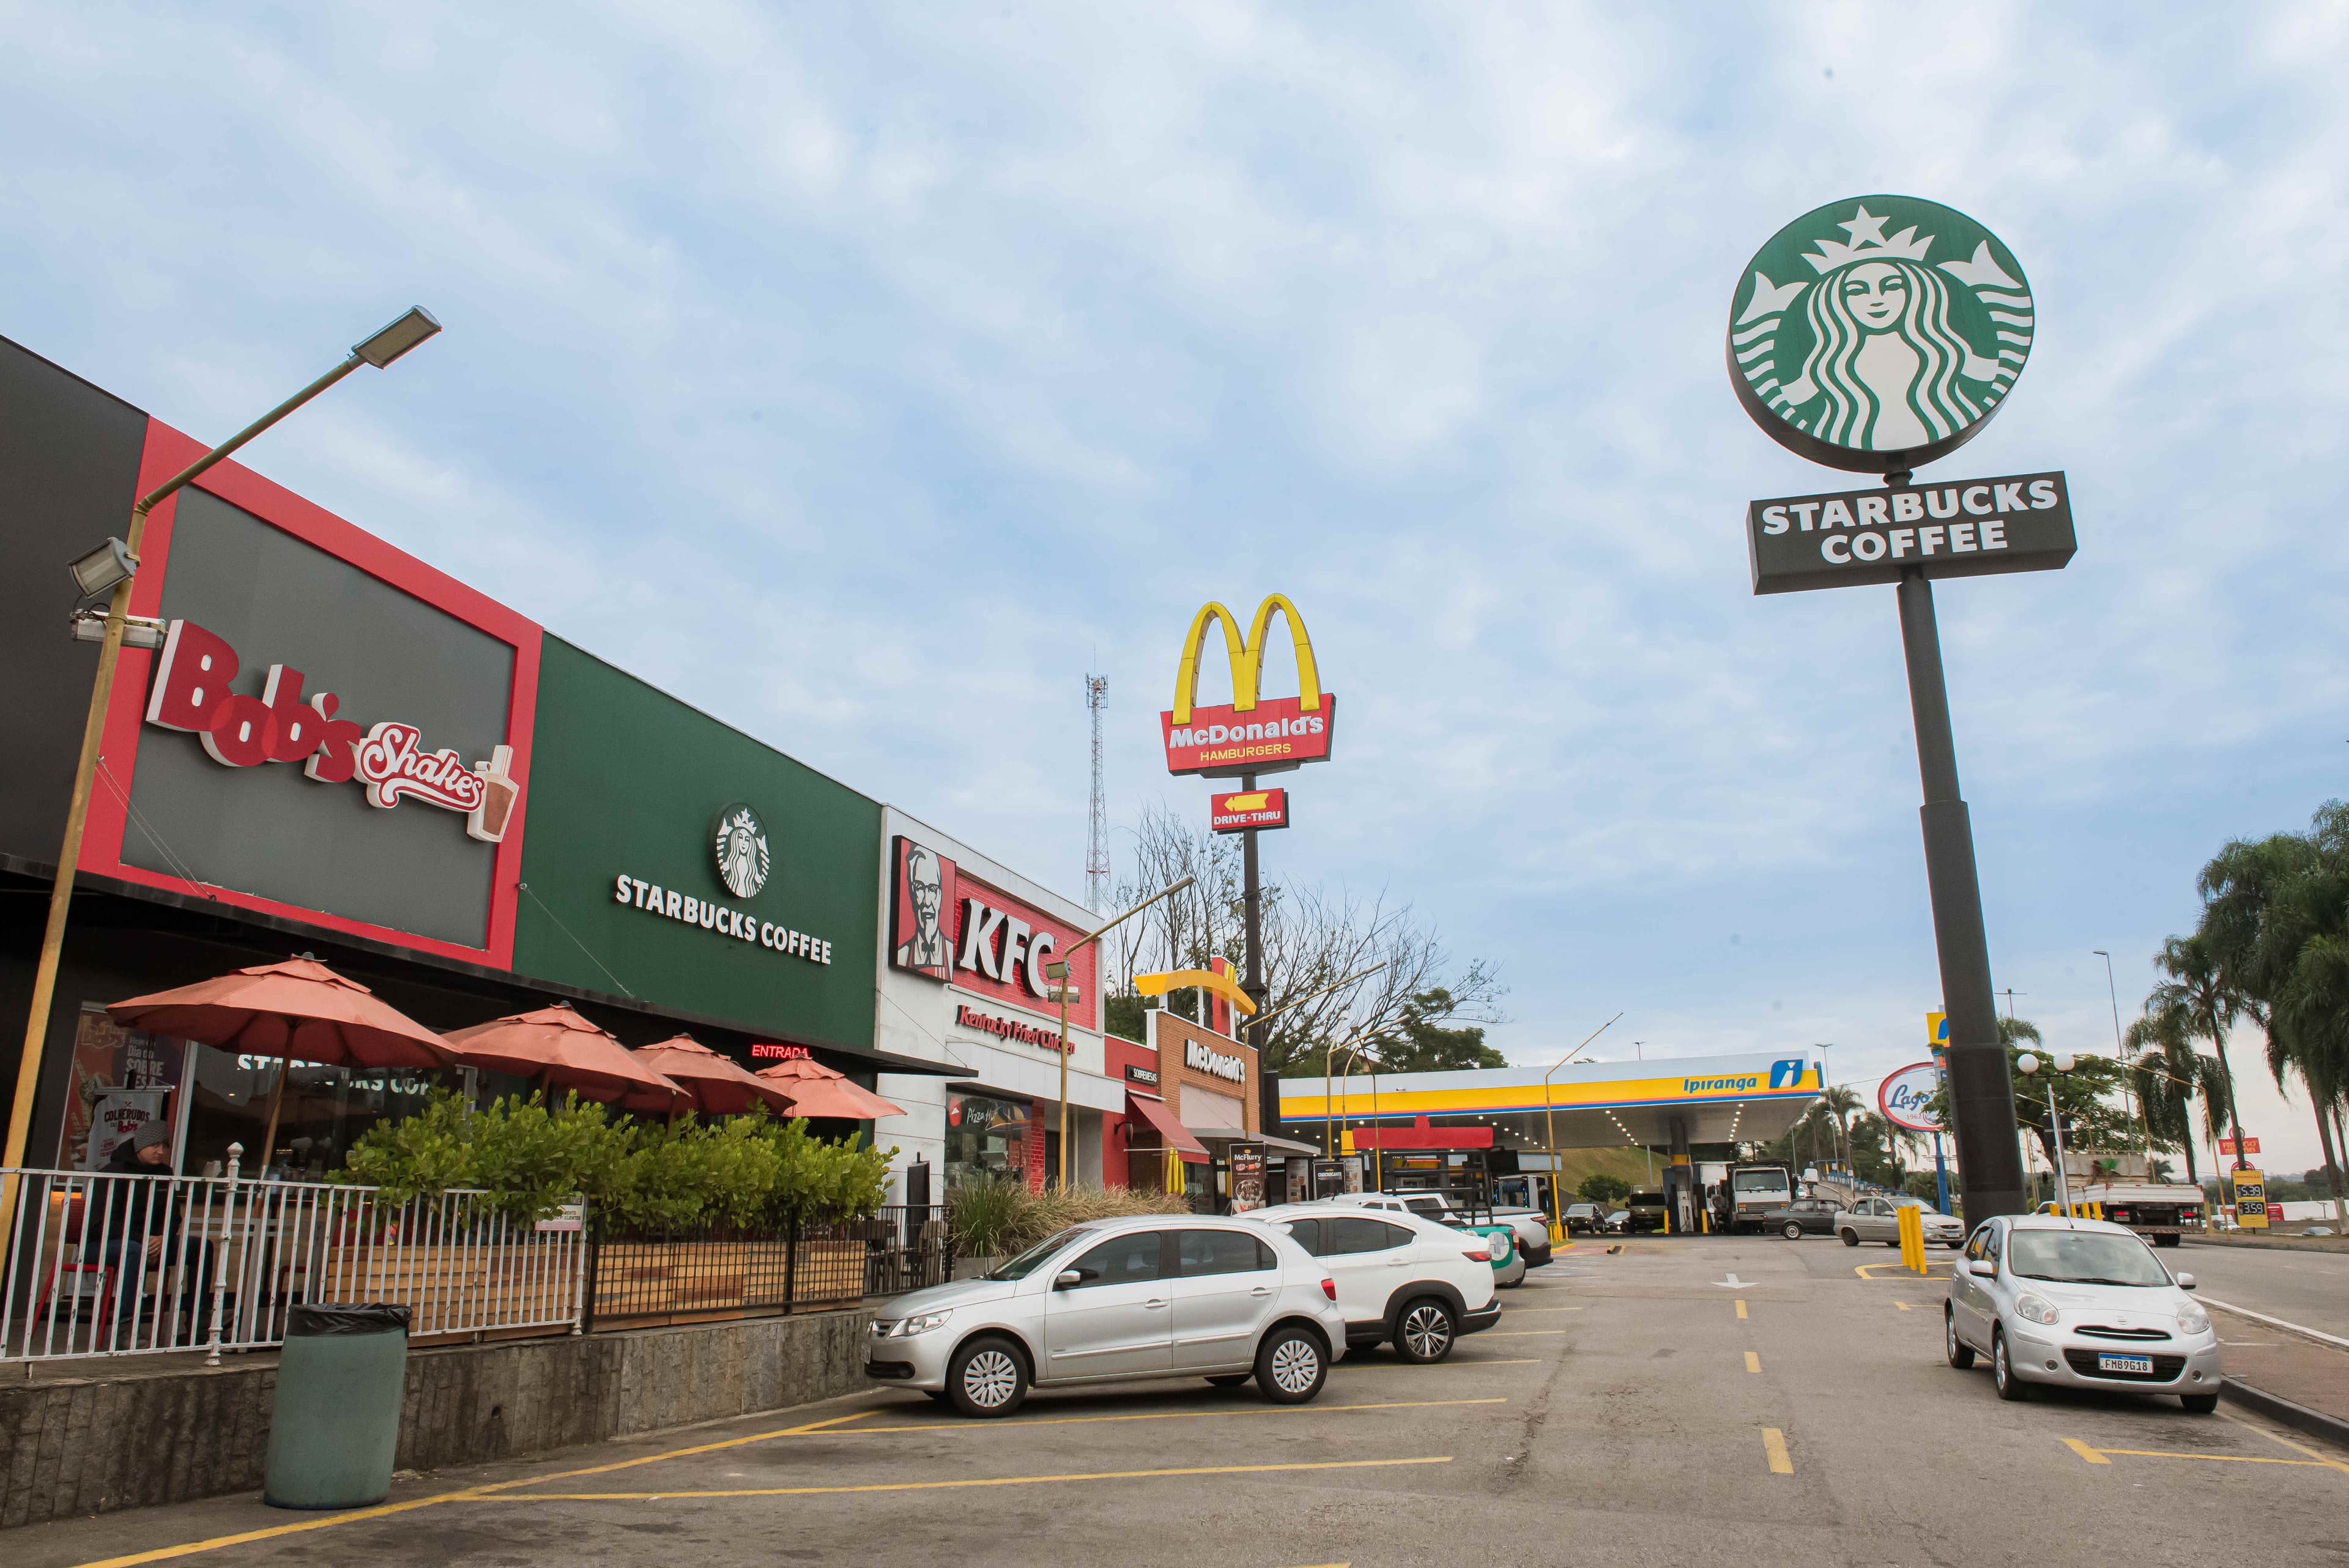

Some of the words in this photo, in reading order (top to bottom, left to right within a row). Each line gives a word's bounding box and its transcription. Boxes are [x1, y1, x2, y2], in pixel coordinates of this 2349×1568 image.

[1762, 480, 2057, 535] STARBUCKS
[1820, 520, 2008, 563] COFFEE
[148, 619, 362, 783] Bob's
[1169, 716, 1324, 749] McDonald's
[1200, 743, 1291, 762] HAMBURGERS
[363, 727, 483, 803] Shakes
[1214, 811, 1281, 826] DRIVE-THRU
[616, 874, 757, 942] STARBUCKS
[761, 921, 832, 965] COFFEE
[959, 898, 1055, 998] KFC
[958, 1005, 1012, 1040] Kentucky
[1012, 1021, 1039, 1044] Fried
[1041, 1030, 1076, 1055] Chicen
[127, 1045, 141, 1057] Dia
[752, 1044, 809, 1058] ENTRADA
[125, 1058, 165, 1077] SOBRE
[1186, 1039, 1245, 1083] McDonald's
[1133, 1068, 1157, 1082] SOBREMESAS
[1683, 1077, 1757, 1094] Ipiranga
[1887, 1084, 1931, 1112] Lago
[967, 1107, 984, 1125] Pizza
[2241, 1186, 2261, 1196] 5.39
[2244, 1203, 2263, 1213] 3.59
[2105, 1359, 2148, 1371] FMB9G18
